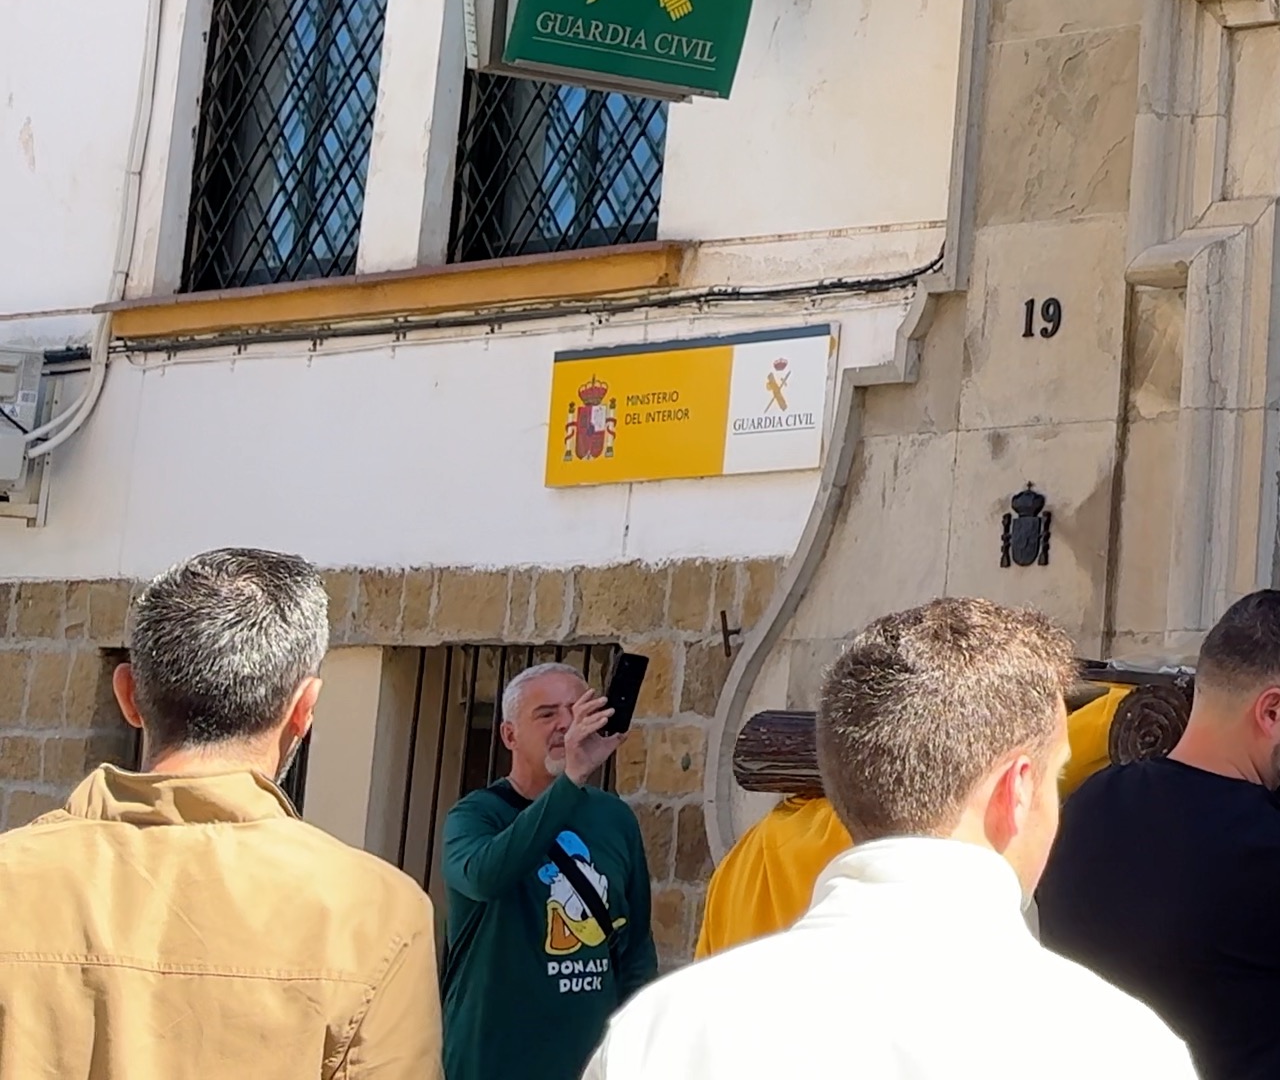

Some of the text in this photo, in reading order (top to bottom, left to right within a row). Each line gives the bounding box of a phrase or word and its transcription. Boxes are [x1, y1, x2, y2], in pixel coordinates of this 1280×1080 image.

[535, 10, 717, 63] GUARDIA CIVIL
[1021, 296, 1063, 339] 19
[626, 390, 680, 407] MINISTERIO
[624, 407, 691, 426] DEL INTERIOR
[733, 412, 816, 432] GUARDIA CIVIL
[547, 958, 609, 976] DONALD
[559, 975, 602, 993] DUCK
